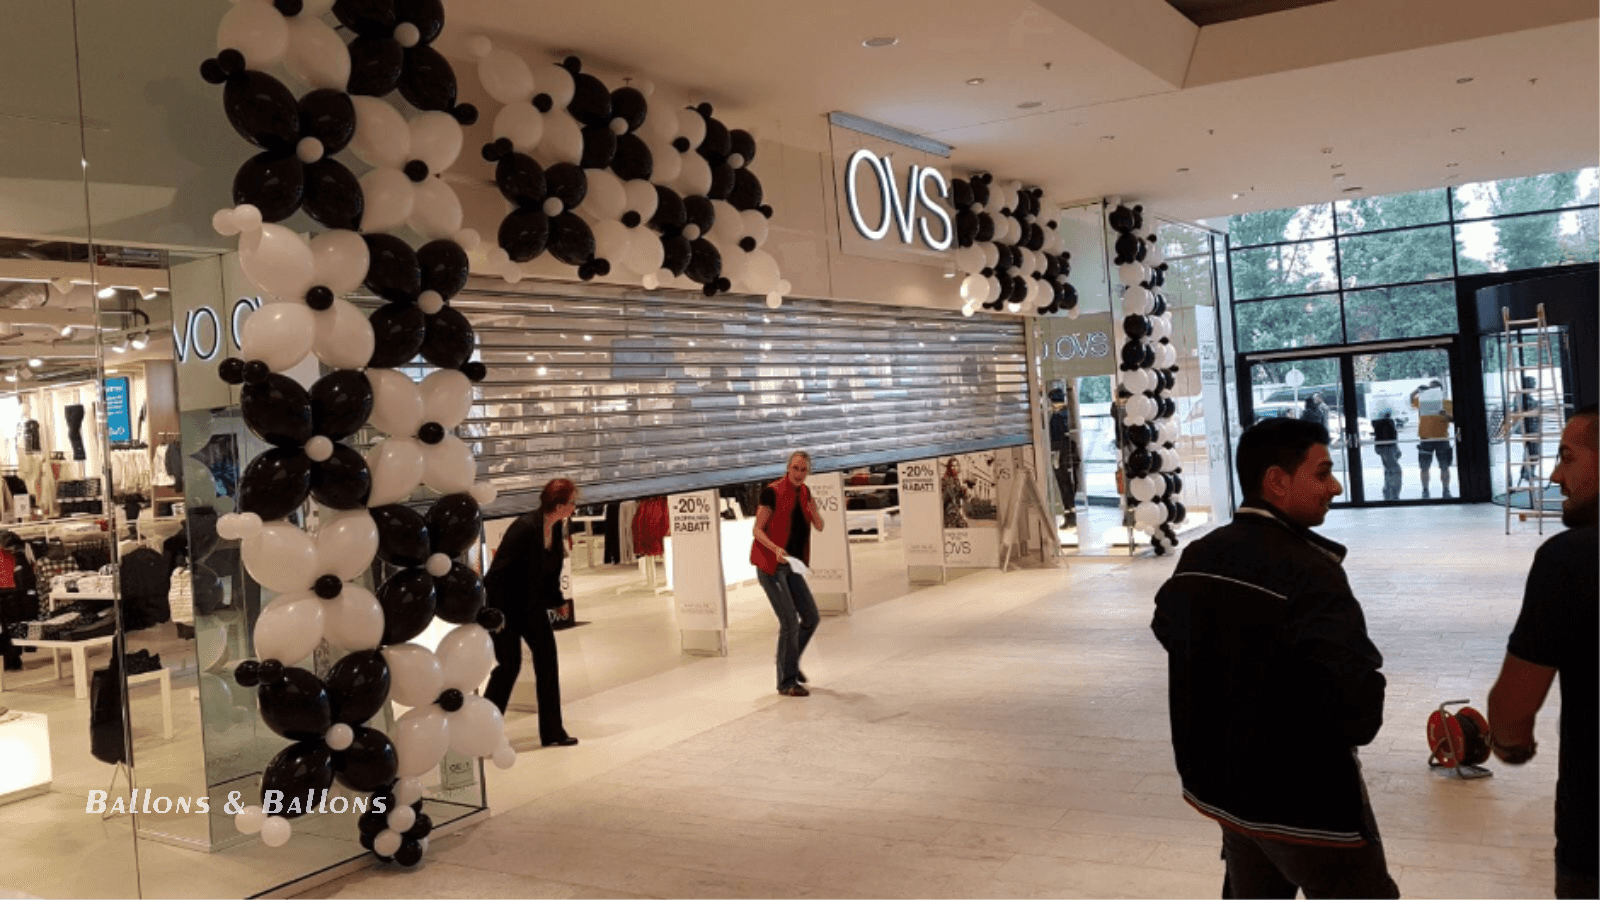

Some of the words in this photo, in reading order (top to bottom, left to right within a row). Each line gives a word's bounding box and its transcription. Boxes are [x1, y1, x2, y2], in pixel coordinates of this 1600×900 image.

[844, 149, 953, 251] OVS
[1055, 332, 1109, 361] OVS
[902, 464, 935, 477] -20%
[673, 498, 711, 513] -20%
[674, 520, 711, 532] RABATT
